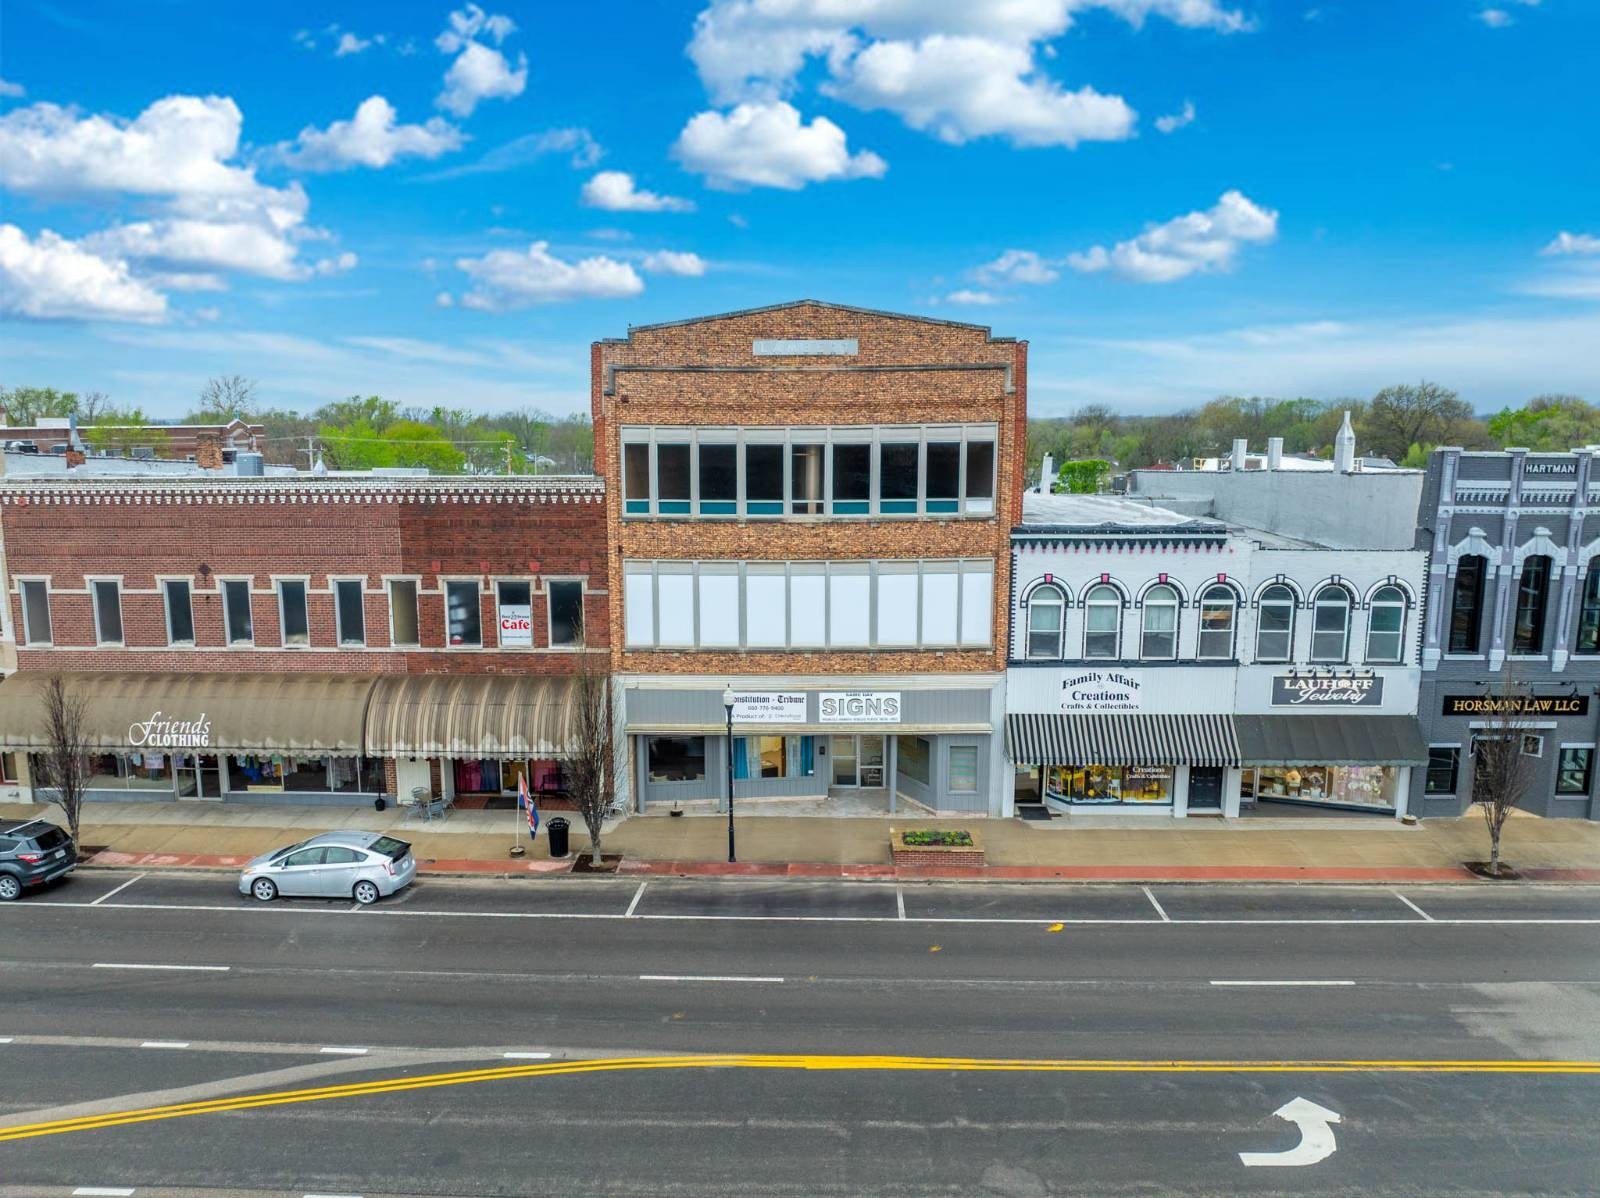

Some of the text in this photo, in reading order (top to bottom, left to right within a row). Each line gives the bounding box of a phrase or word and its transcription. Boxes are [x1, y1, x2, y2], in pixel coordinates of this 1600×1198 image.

[1525, 464, 1576, 474] HARTMAN
[502, 619, 530, 630] Cafe
[1062, 672, 1140, 690] Family Affair
[1283, 679, 1374, 689] LAUHOFF
[734, 695, 770, 704] onstitution
[777, 694, 805, 704] Tribune
[1072, 690, 1130, 701] Creations
[1290, 687, 1366, 704] Jewelry
[821, 697, 899, 716] SIGNS
[1453, 700, 1580, 711] HORSMAN LAW LLC
[148, 733, 209, 747] CLOTHING
